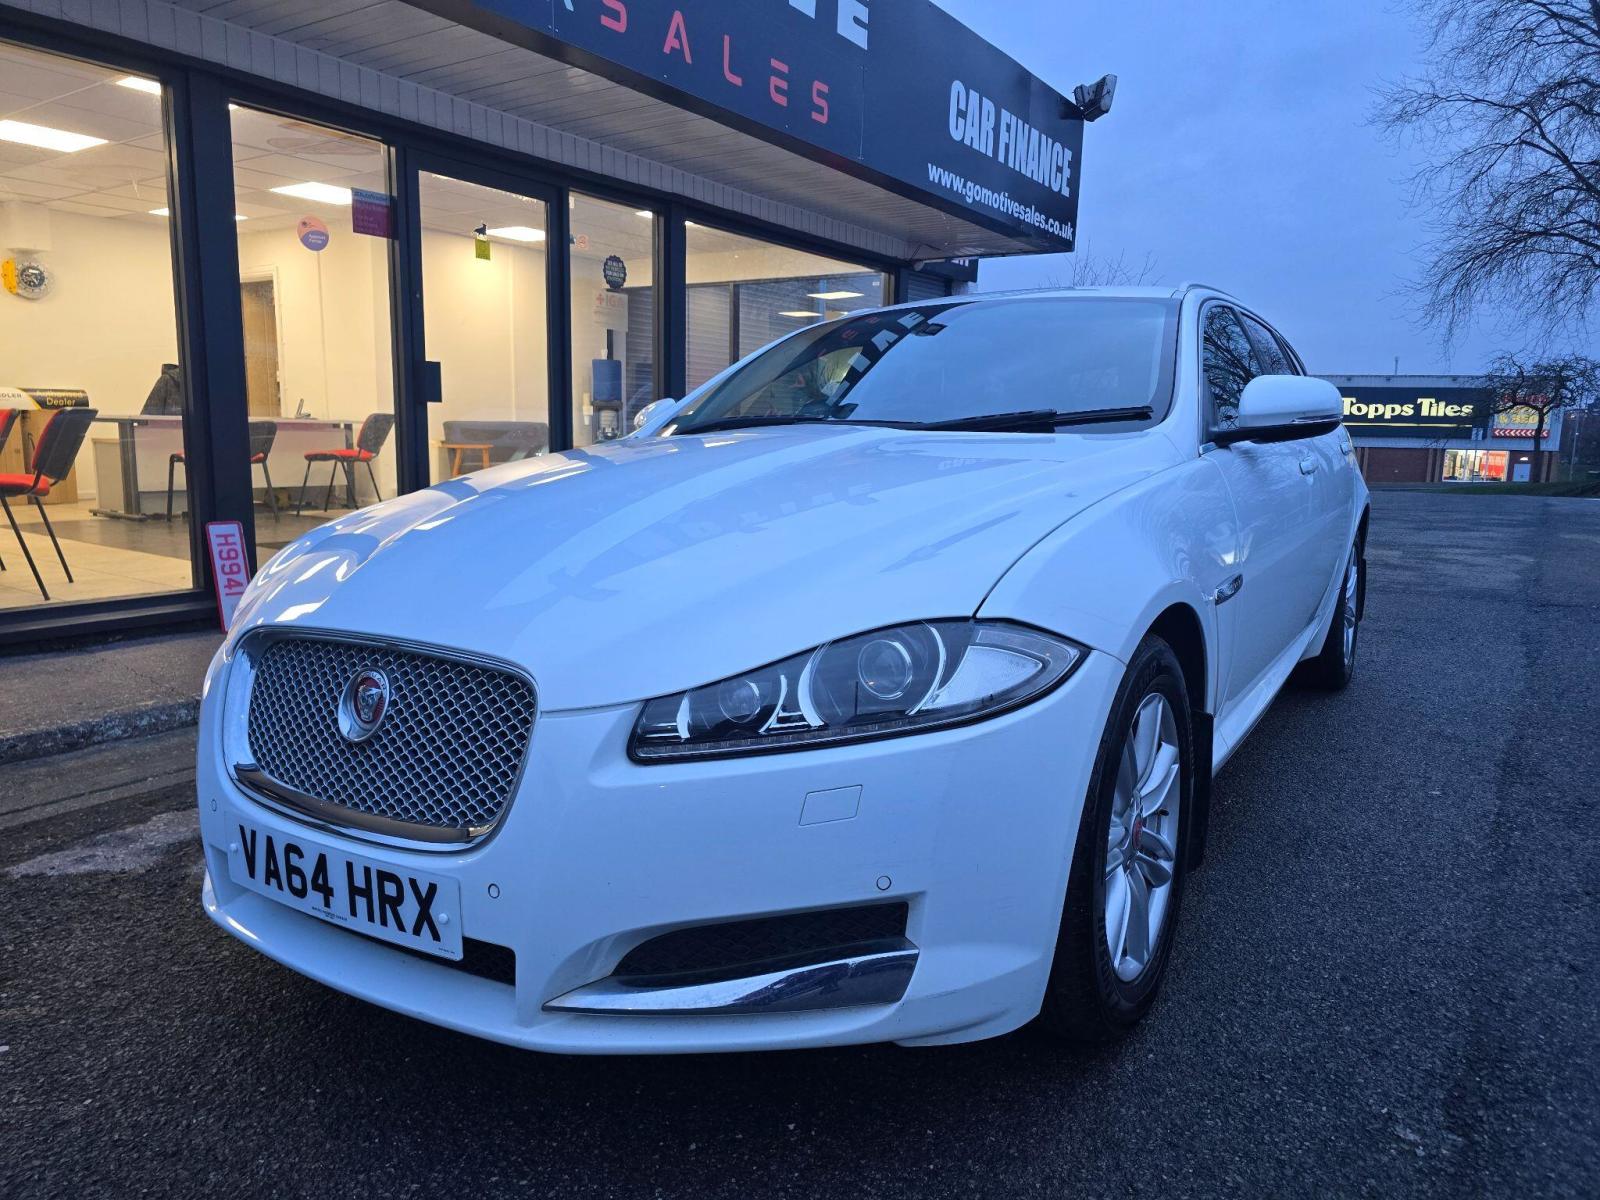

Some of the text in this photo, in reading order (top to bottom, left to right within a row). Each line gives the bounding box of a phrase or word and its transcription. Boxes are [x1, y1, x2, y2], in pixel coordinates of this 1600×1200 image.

[600, 0, 829, 124] SALES
[949, 80, 1072, 198] CAR FINANCE
[928, 163, 1073, 241] www.gomotivesales.co.uk
[46, 397, 76, 406] Dealer
[1341, 397, 1473, 419] Topps Tiles
[239, 824, 441, 942] VA64 HRX
